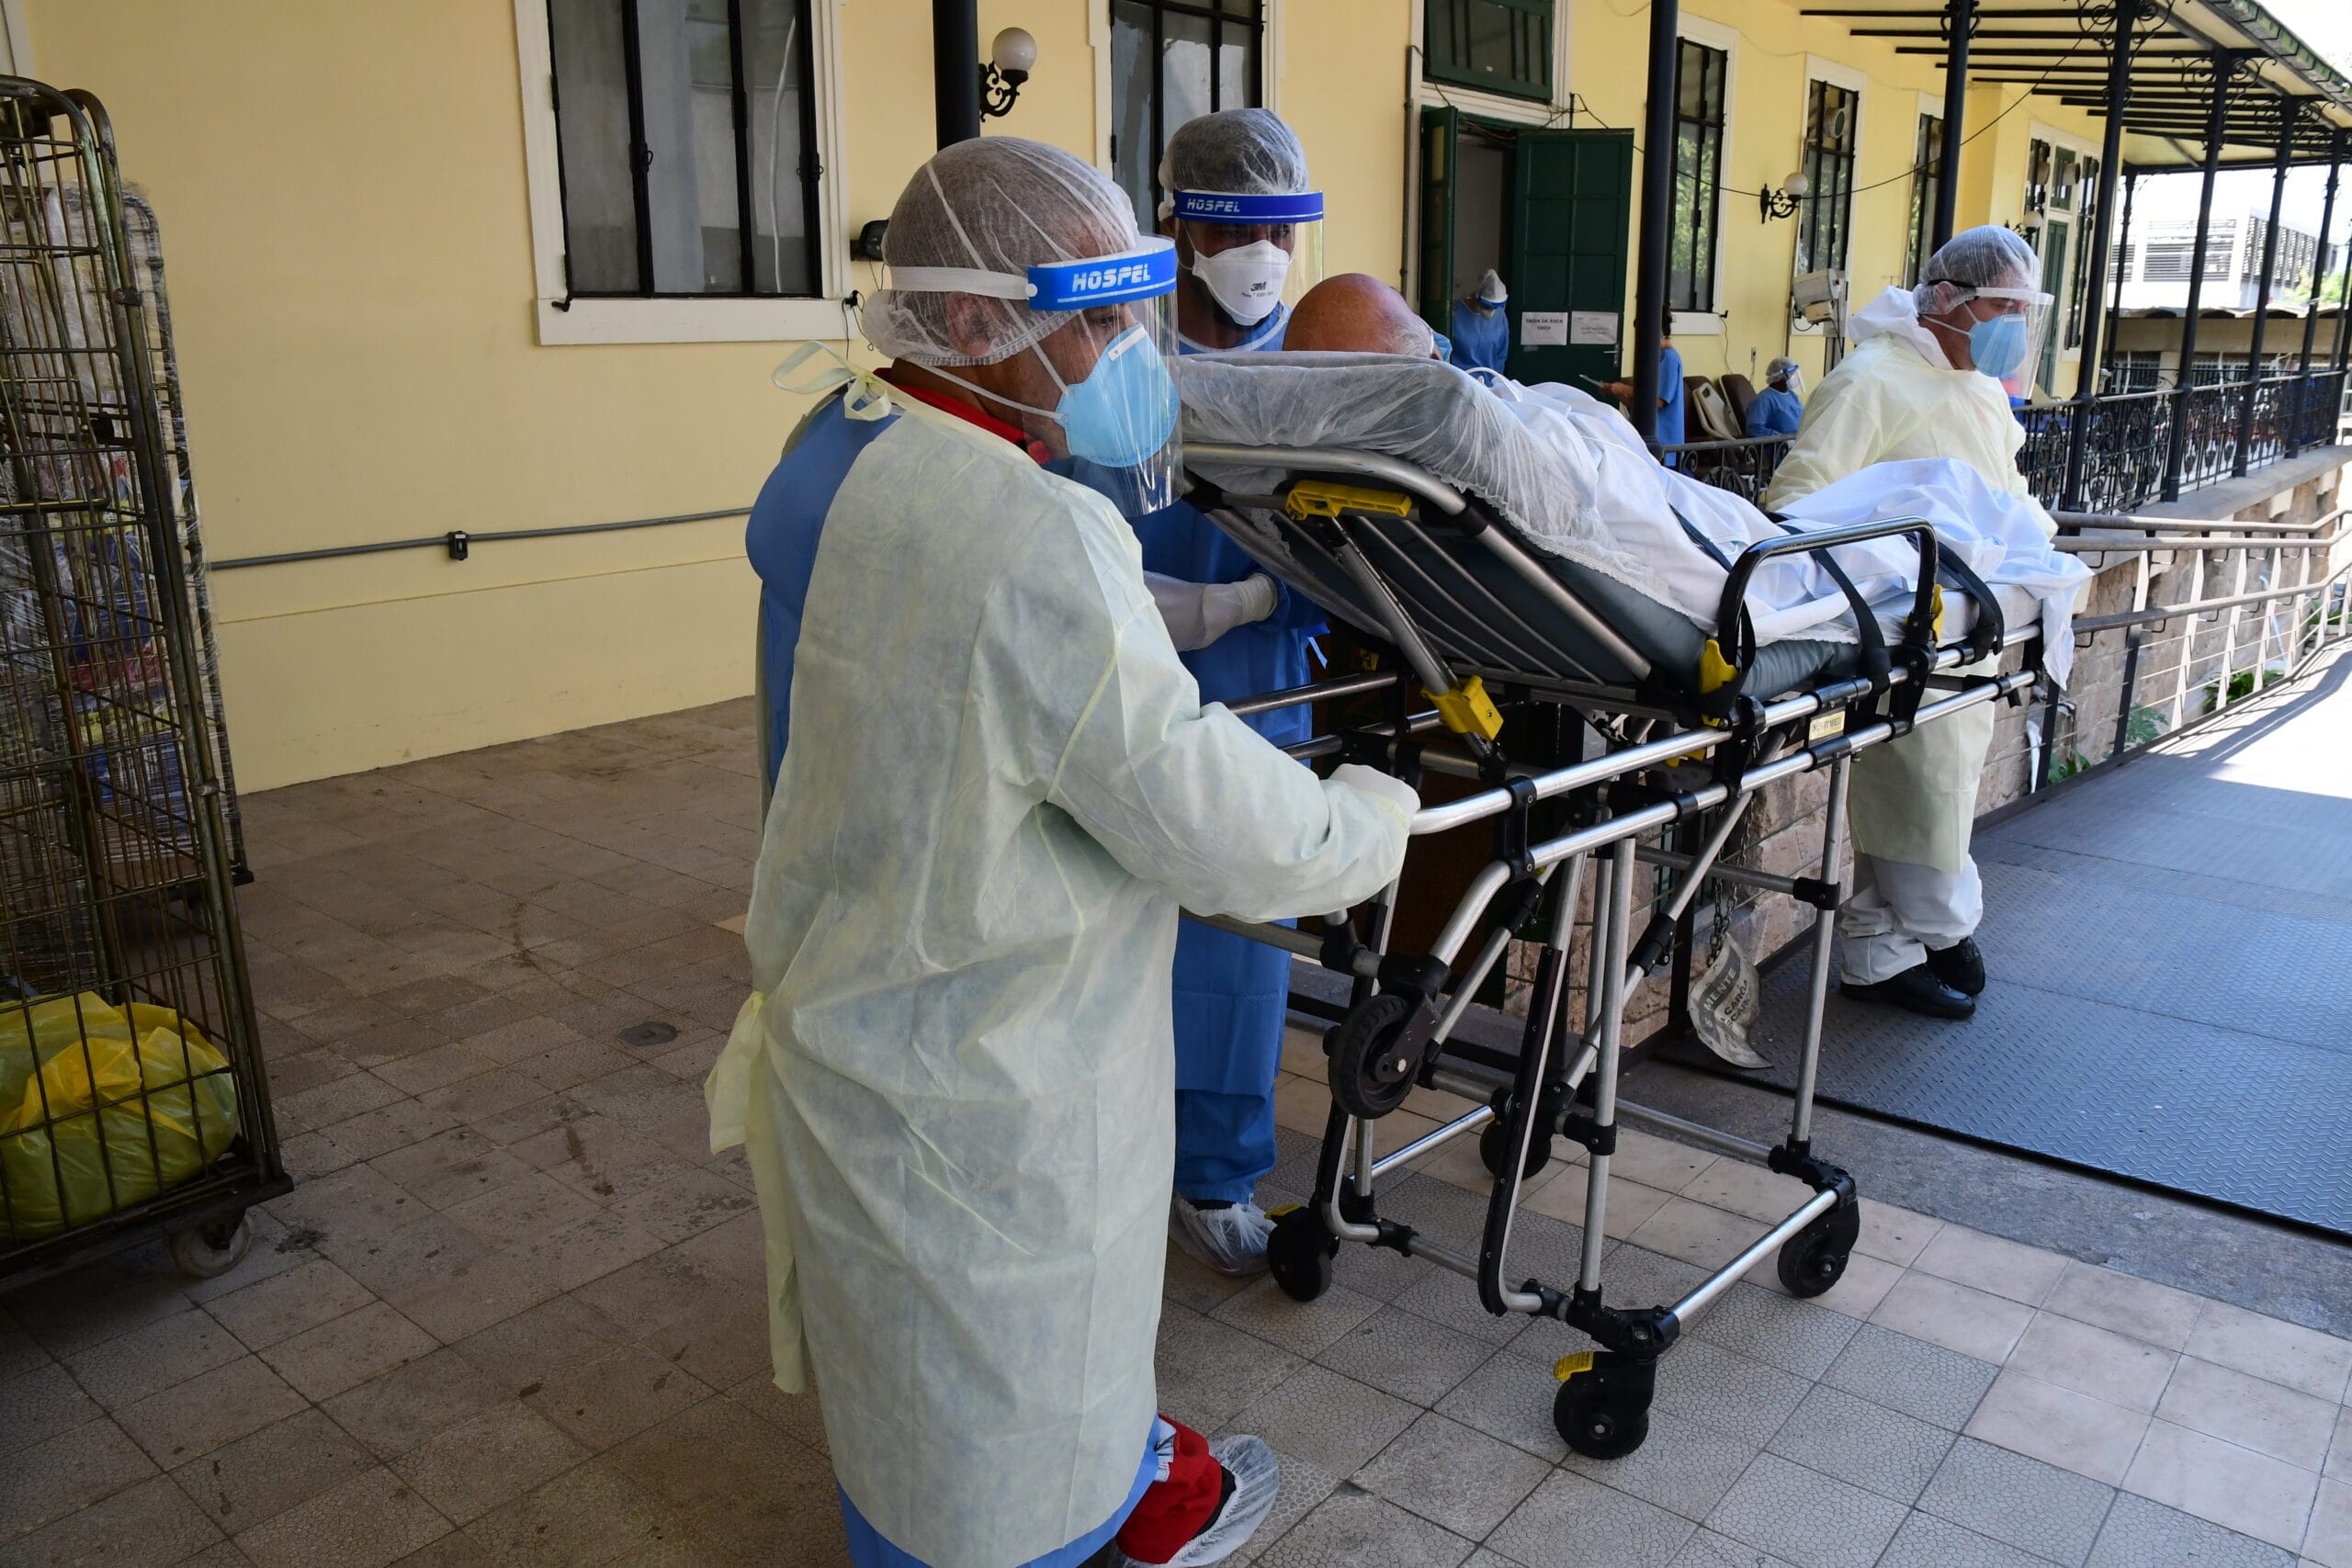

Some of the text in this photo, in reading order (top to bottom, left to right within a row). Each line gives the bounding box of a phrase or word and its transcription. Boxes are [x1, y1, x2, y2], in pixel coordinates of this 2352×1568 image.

[1187, 197, 1240, 213] HOSPEL
[1072, 263, 1151, 292] HOSPEL
[1250, 281, 1267, 291] 3M
